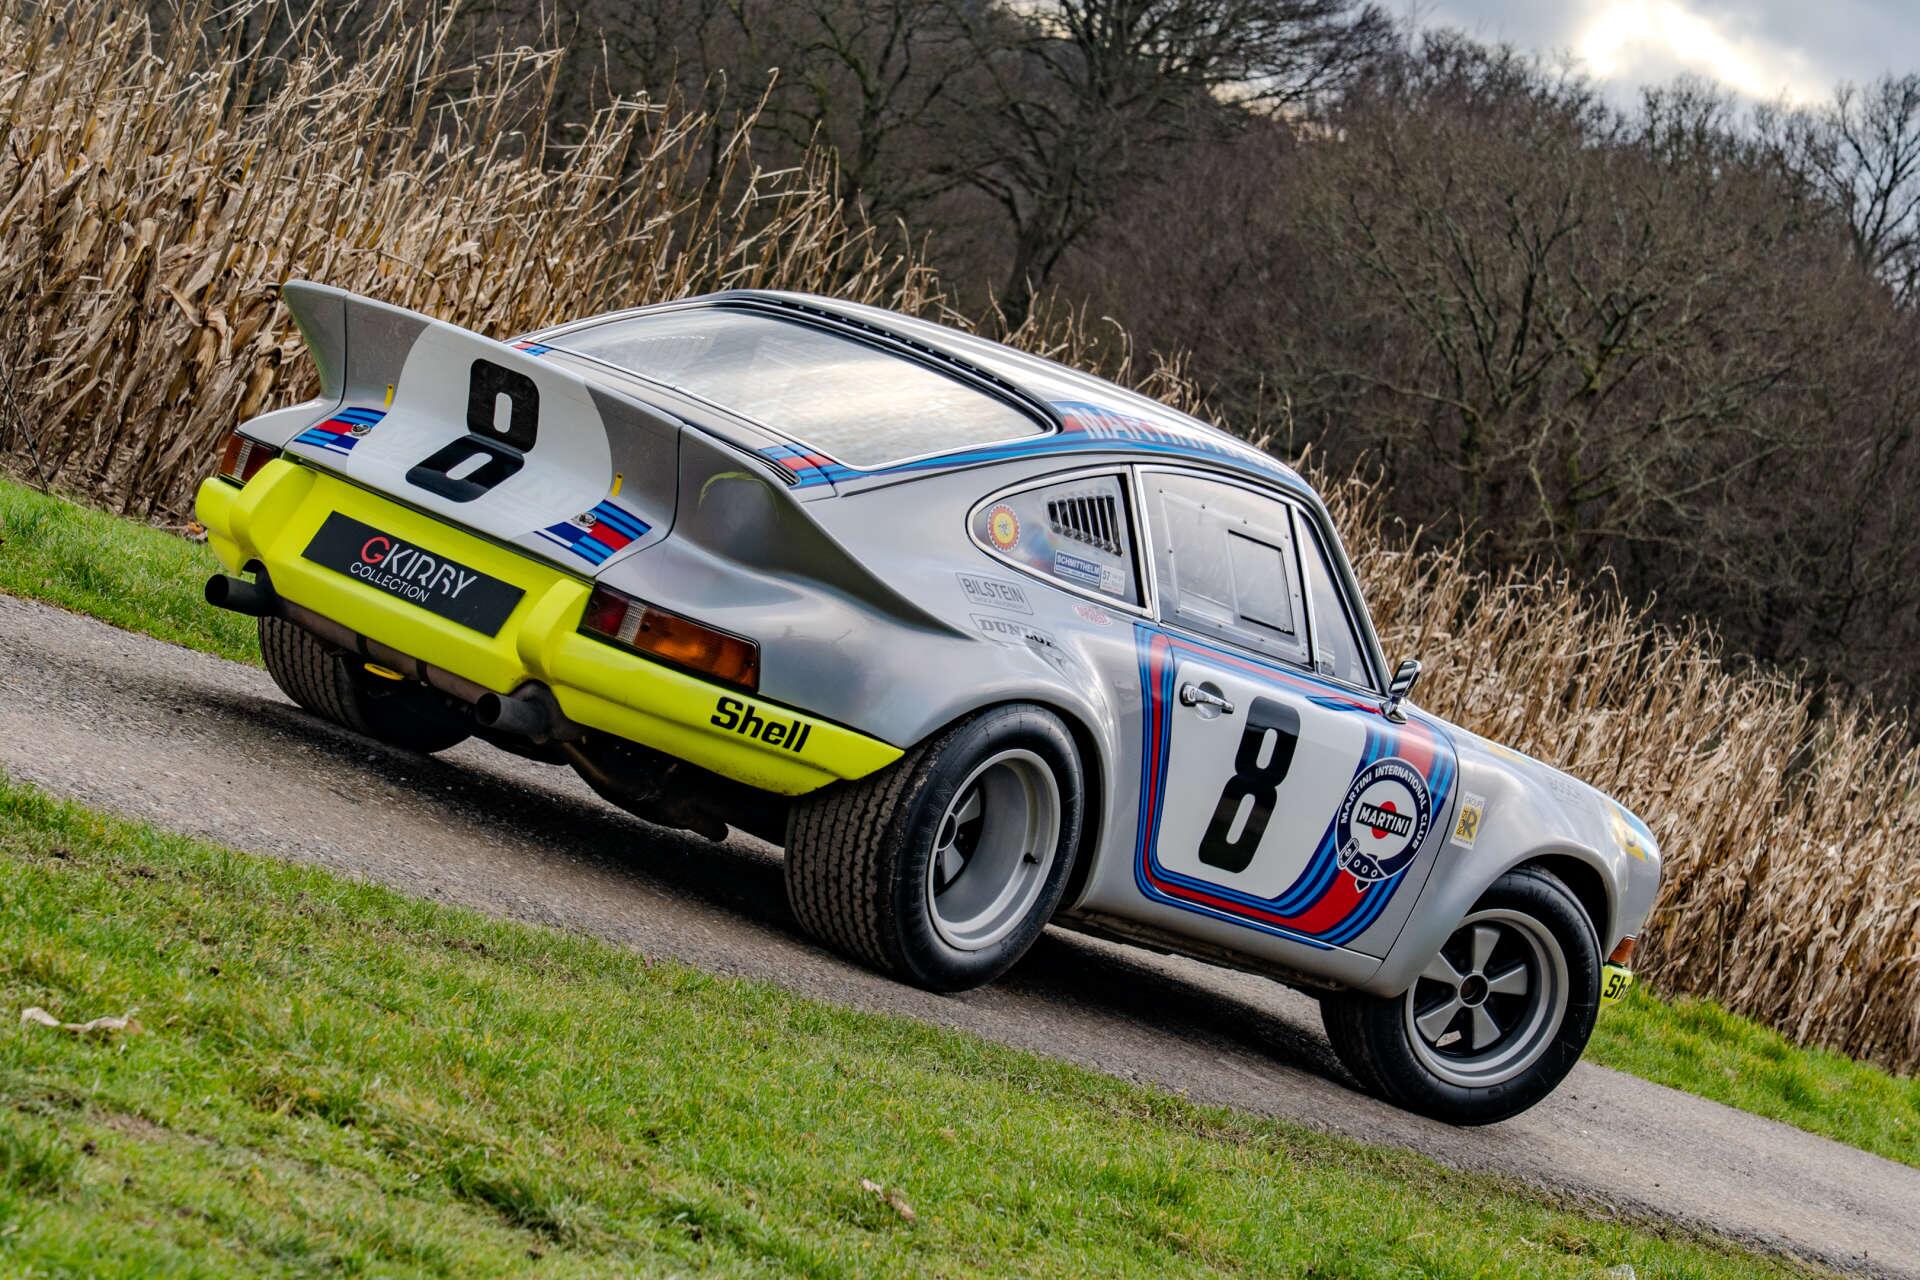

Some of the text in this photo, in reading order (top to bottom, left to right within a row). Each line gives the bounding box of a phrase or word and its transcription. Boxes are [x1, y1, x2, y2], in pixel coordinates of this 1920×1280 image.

[405, 358, 540, 503] 8
[350, 561, 430, 602] COLLECTION
[961, 577, 1026, 604] BILSTEIN
[710, 696, 812, 753] Shell
[1198, 695, 1300, 873] 8
[1341, 771, 1373, 824] MARTINI
[1375, 764, 1428, 810] INTERNATIONAL
[1412, 812, 1428, 850] CLUB
[1359, 806, 1410, 834] MARTINI
